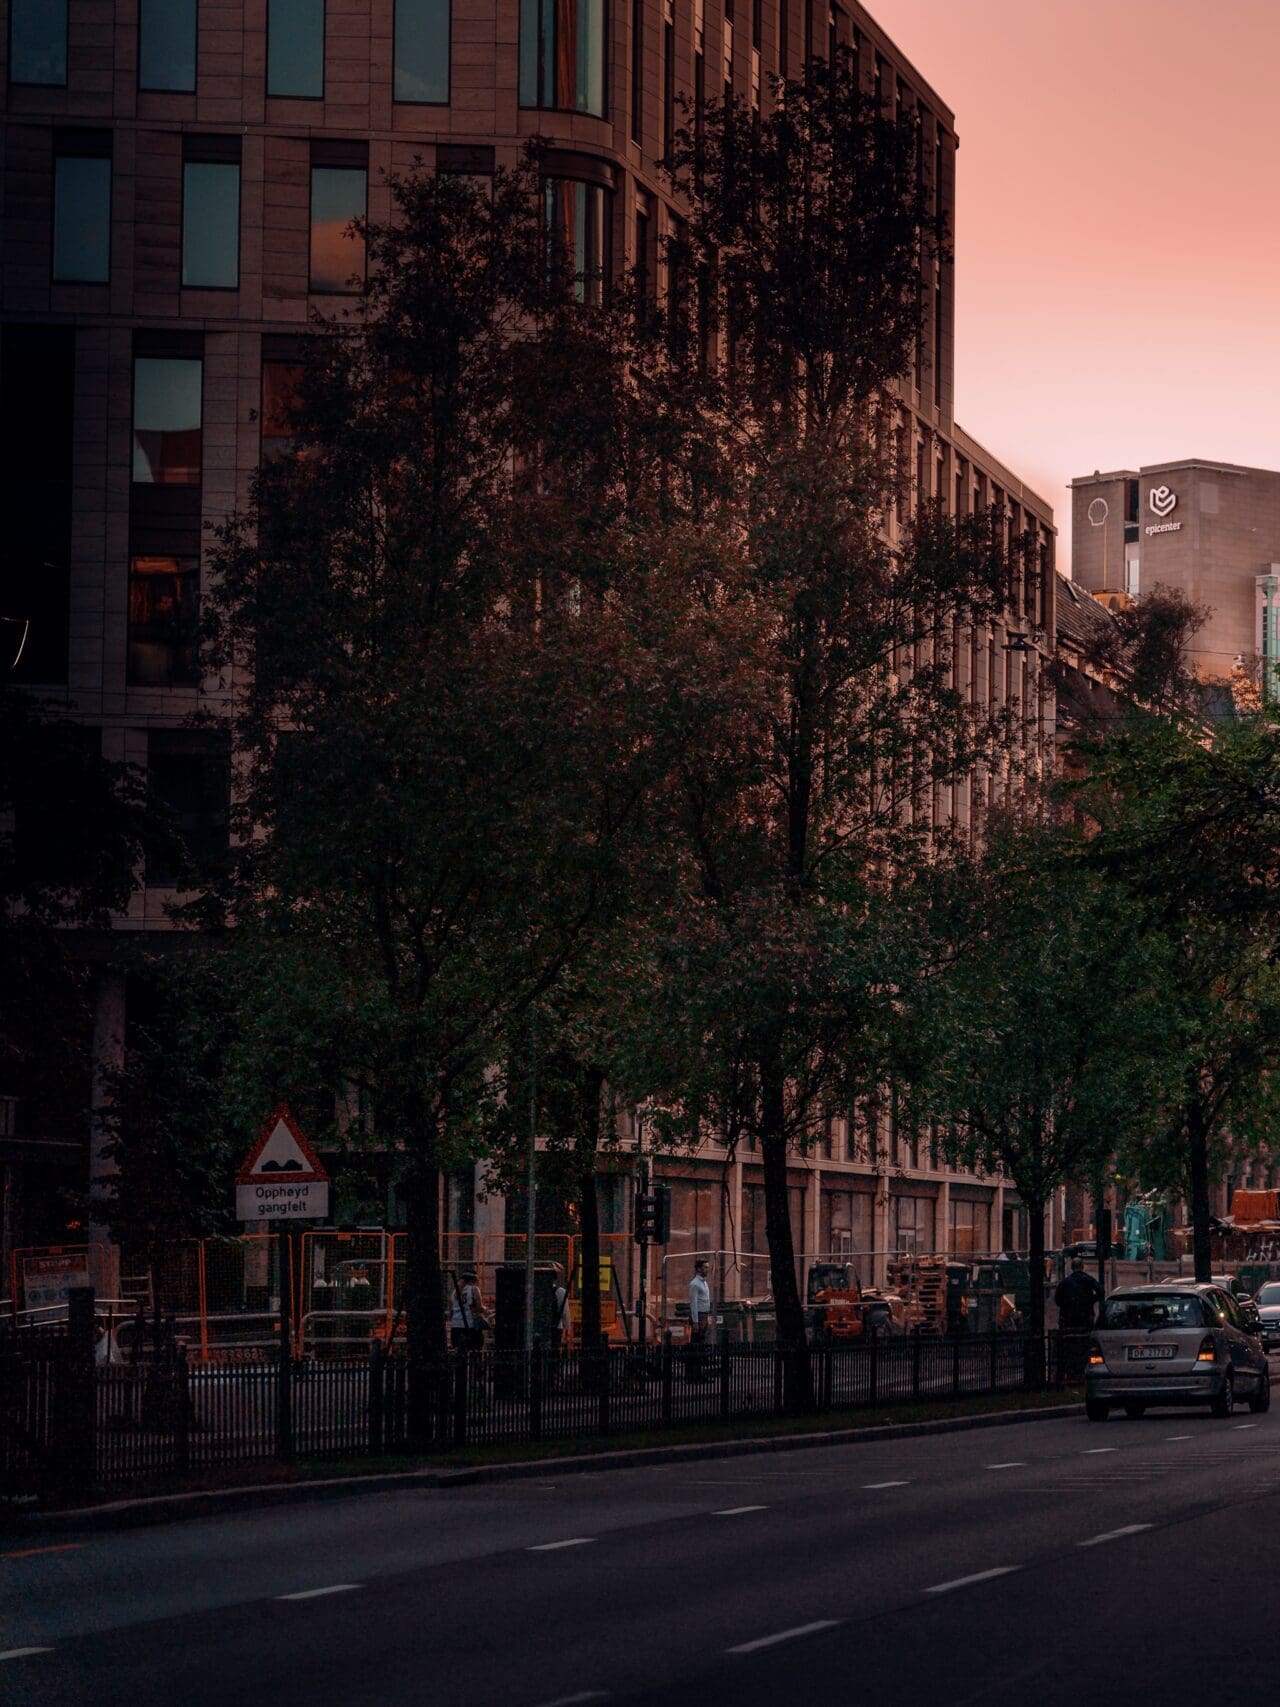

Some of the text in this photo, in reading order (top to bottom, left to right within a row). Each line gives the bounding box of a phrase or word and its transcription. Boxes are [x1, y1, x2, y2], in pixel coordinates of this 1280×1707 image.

[1145, 522, 1181, 536] epicenter
[255, 1185, 309, 1199] Opphøyd
[258, 1201, 307, 1215] gangfelt
